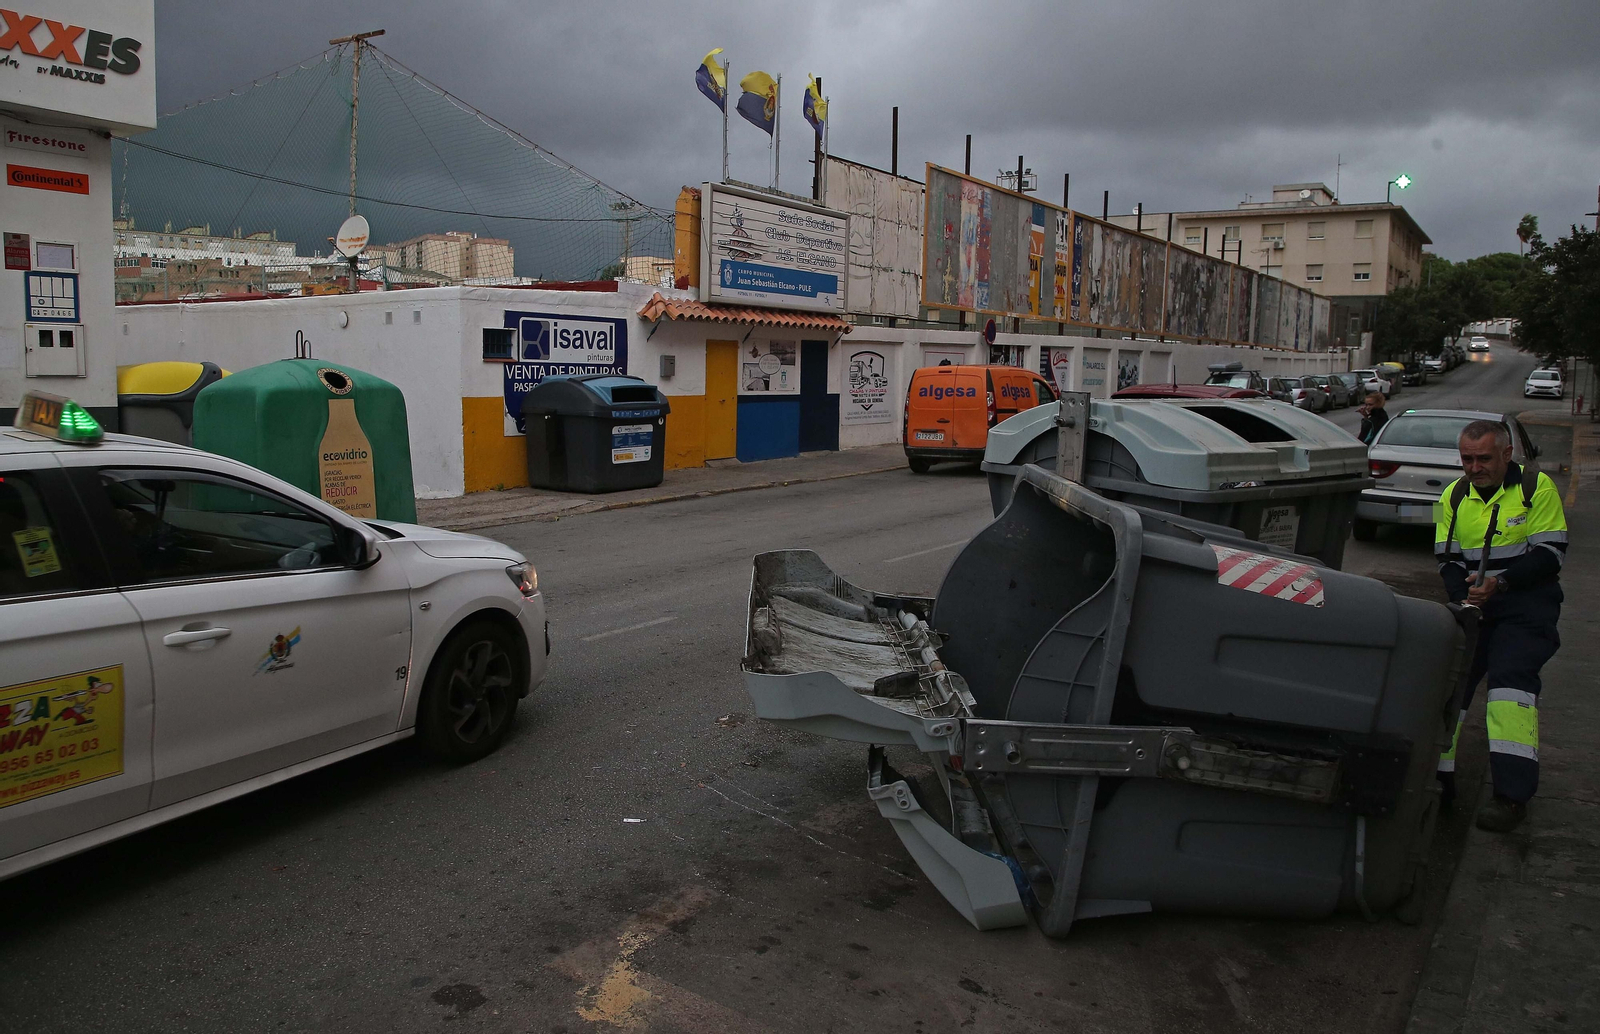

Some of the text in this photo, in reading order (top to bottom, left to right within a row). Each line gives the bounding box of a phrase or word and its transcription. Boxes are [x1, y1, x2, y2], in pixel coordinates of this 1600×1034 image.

[37, 65, 106, 85] BY MAXXIS
[7, 130, 86, 152] Firestone
[12, 170, 74, 187] Continental
[778, 209, 835, 233] Sede Social
[765, 226, 844, 251] Club Deportivo
[796, 251, 837, 268] ELCANO
[737, 268, 775, 279] CAMPO MUNICIPAL
[737, 276, 752, 286] Juan
[752, 278, 778, 289] Sebastián
[778, 281, 795, 291] Elcano
[799, 284, 812, 293] PULE
[553, 321, 614, 351] isaval
[587, 353, 614, 362] pinturas
[505, 364, 547, 380] VENTA
[549, 365, 565, 376] DE
[918, 384, 976, 400] algesa
[1001, 382, 1031, 400] algesa
[323, 448, 368, 461] ecovidrio
[325, 486, 358, 498] REDUCIR
[395, 665, 407, 681] 19
[0, 755, 29, 774] 956
[34, 749, 54, 764] 65
[58, 743, 77, 758] 02
[81, 737, 99, 752] 03
